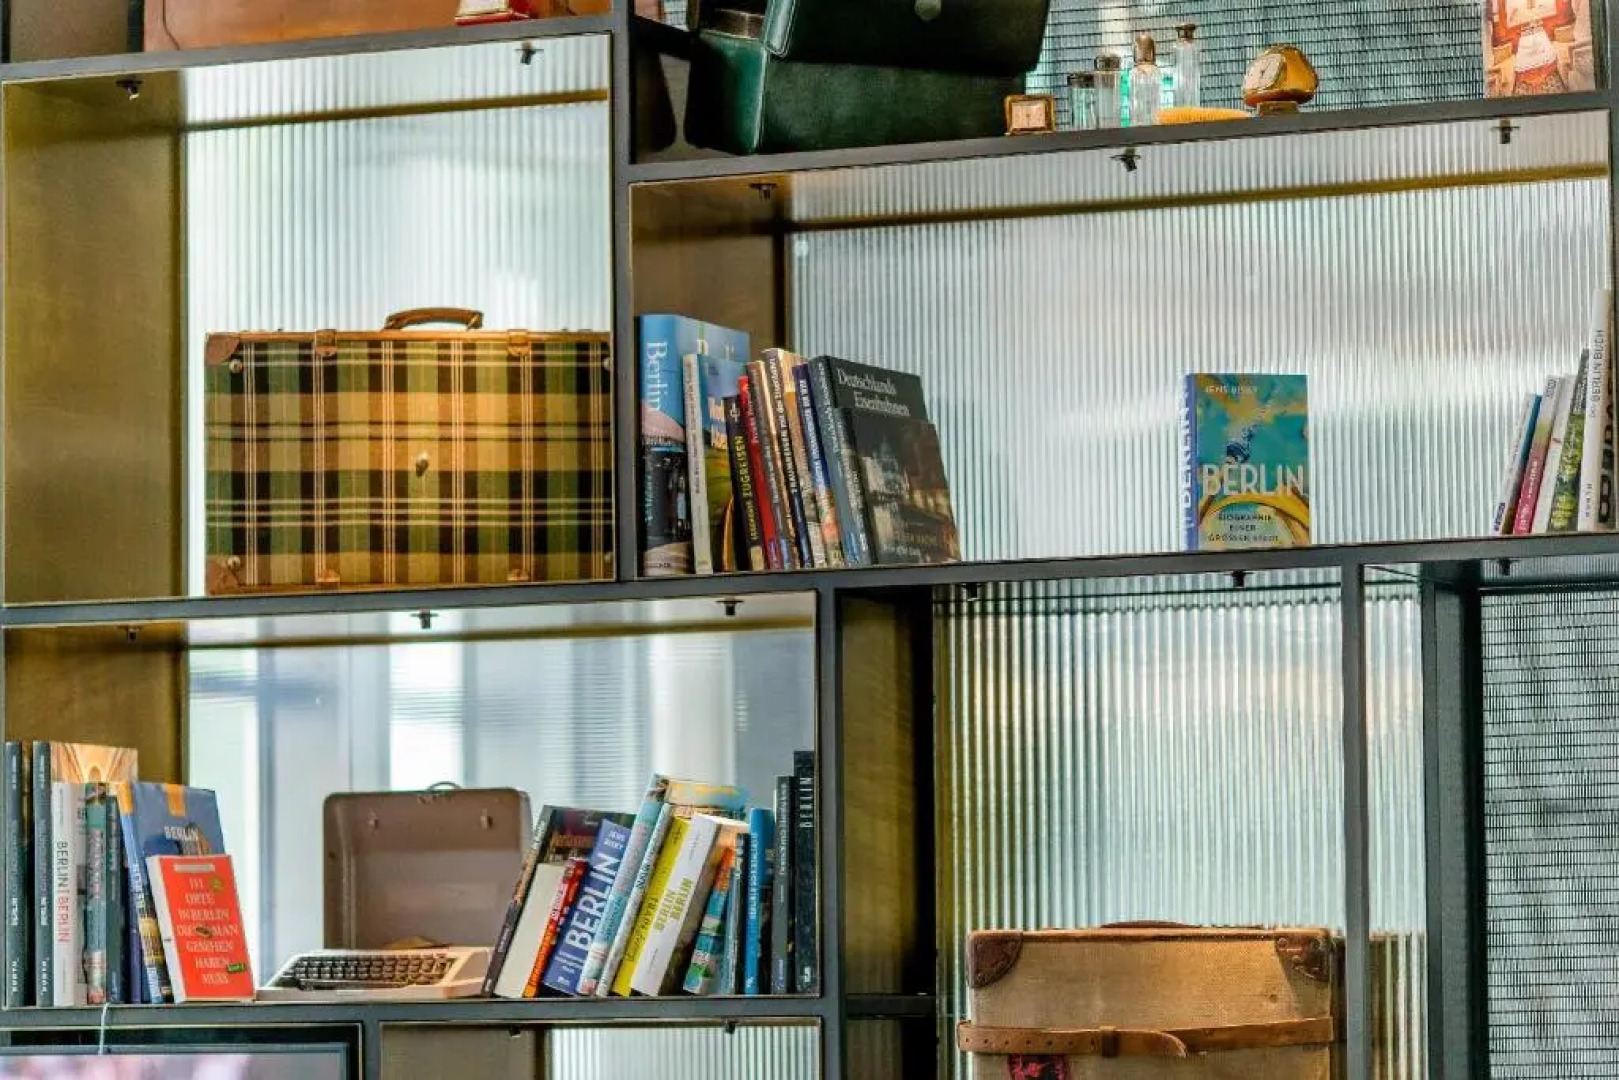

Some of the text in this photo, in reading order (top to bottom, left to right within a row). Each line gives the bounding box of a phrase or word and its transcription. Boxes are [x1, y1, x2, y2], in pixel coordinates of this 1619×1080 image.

[1593, 330, 1605, 359] BUCH
[645, 340, 668, 412] Berlin
[1591, 361, 1602, 403] BERLIN
[1202, 462, 1305, 497] BERLIN
[799, 776, 814, 829] BERLIN
[164, 826, 199, 841] BERLIN
[57, 840, 70, 942] BERLIN BERLIN
[566, 851, 621, 953] BERLIN
